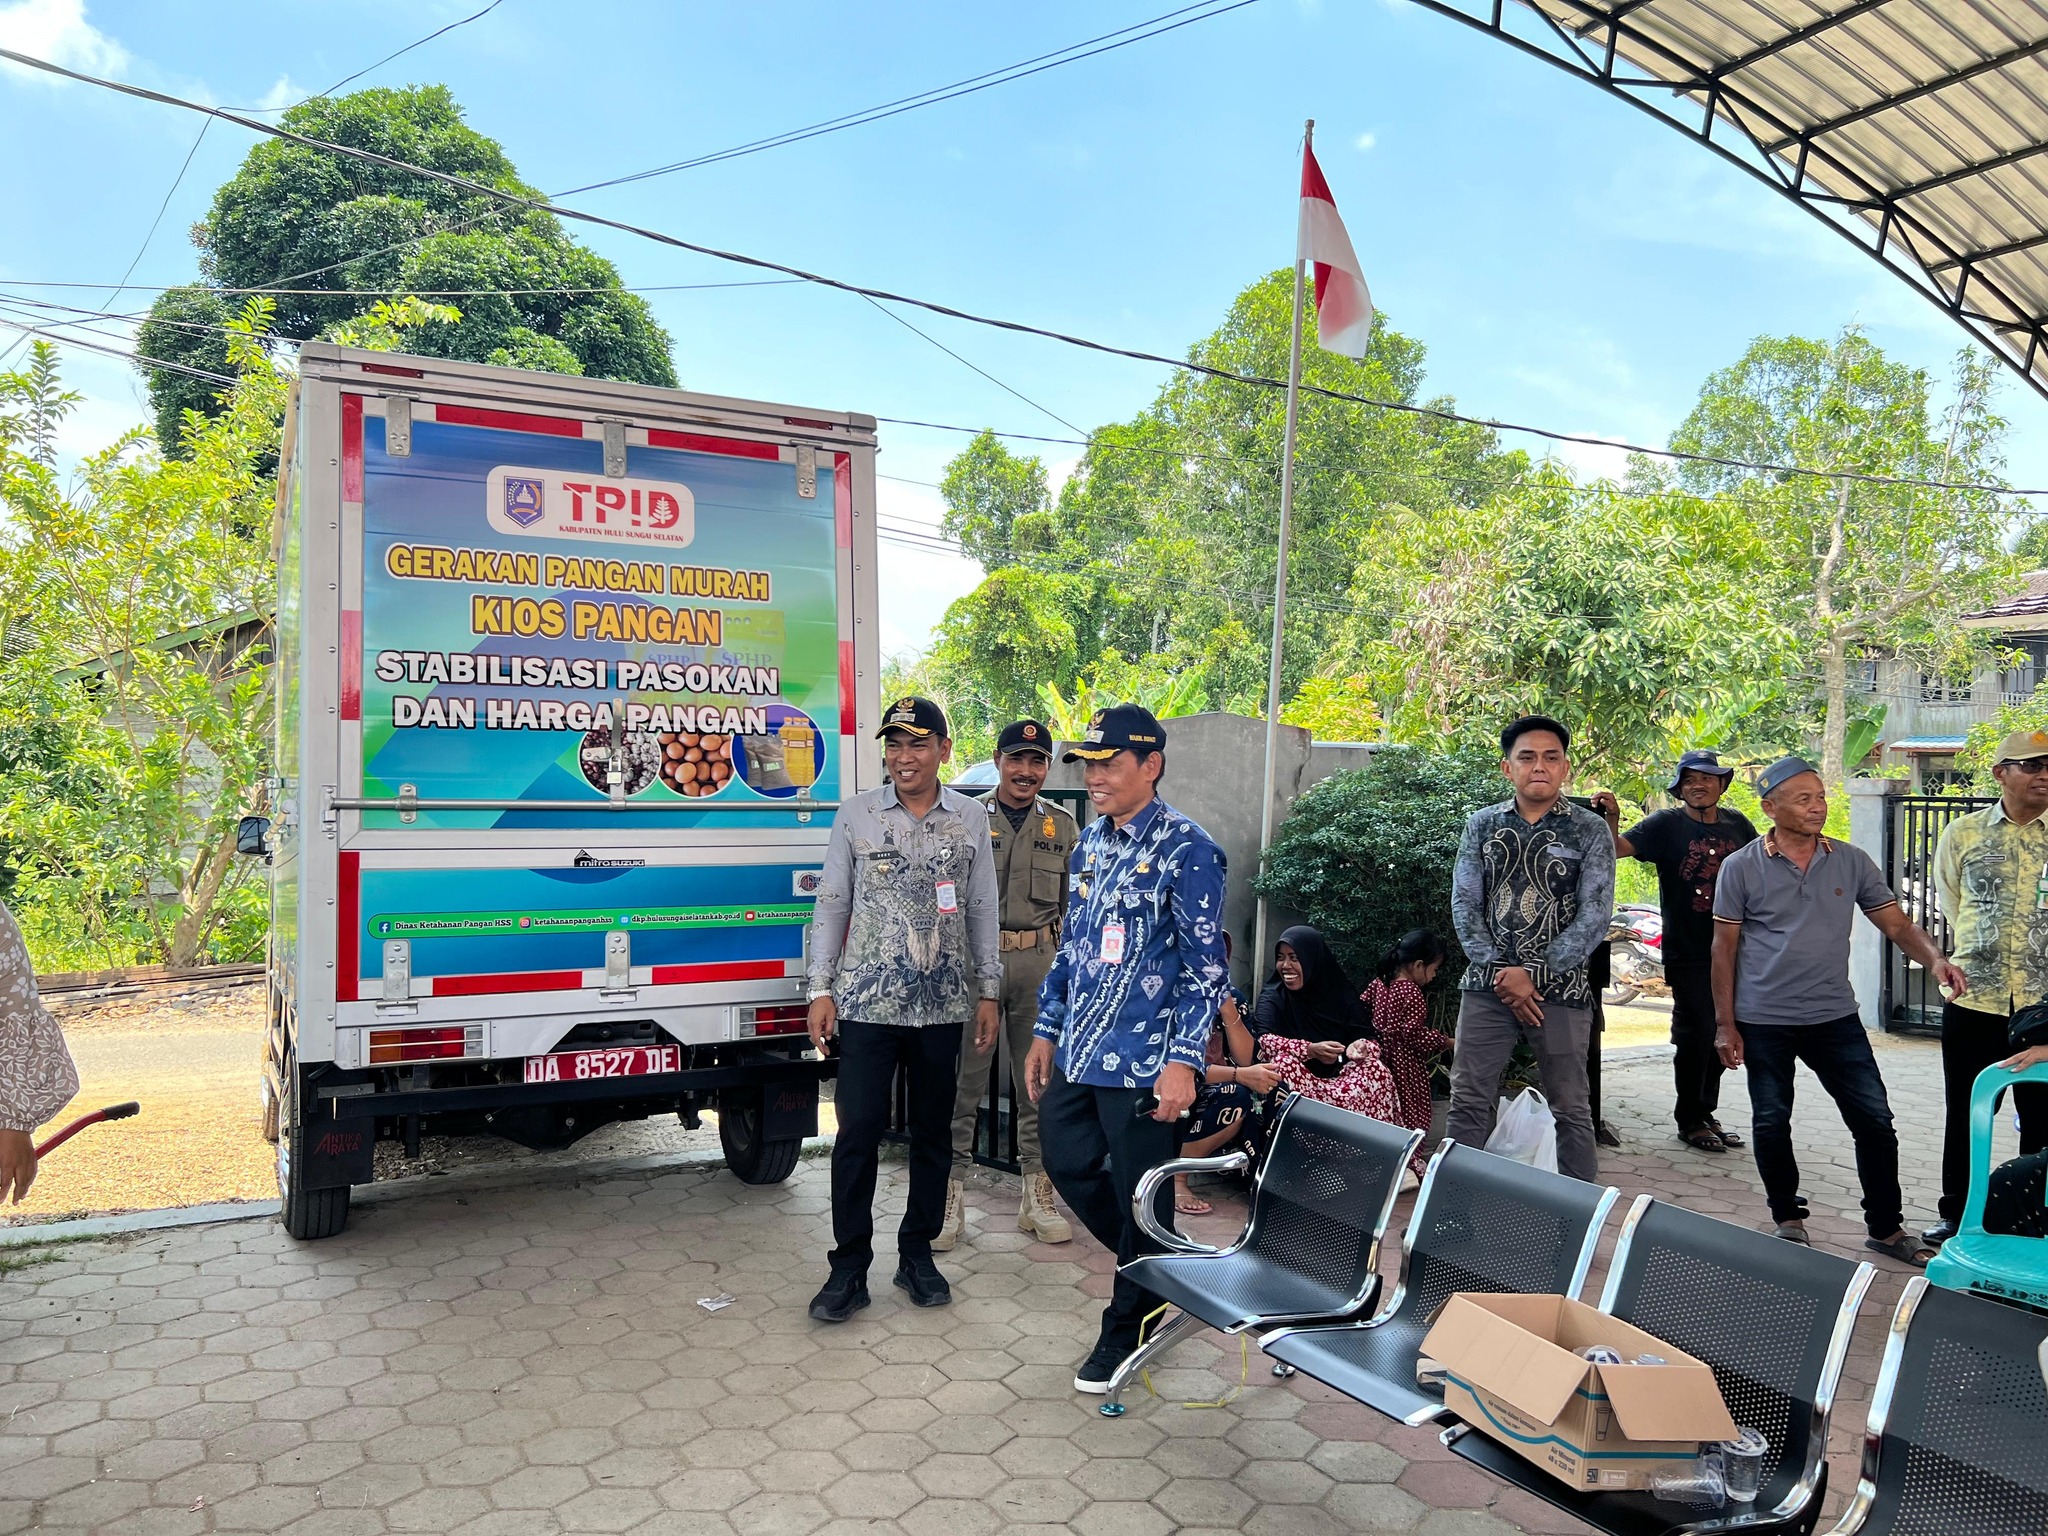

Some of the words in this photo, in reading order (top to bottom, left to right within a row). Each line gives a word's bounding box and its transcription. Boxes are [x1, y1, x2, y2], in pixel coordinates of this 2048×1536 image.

[559, 525, 602, 535] KABUPATEN
[604, 529, 624, 537] HULU
[626, 531, 652, 540] SUNGAI
[654, 533, 684, 542] SELATAN
[387, 544, 539, 587] GERAKAN
[544, 556, 664, 595] PANGAN
[669, 565, 770, 602] MURAH
[471, 594, 567, 638] KIOS
[573, 601, 722, 647] PANGAN
[721, 651, 773, 666] SPHP
[375, 650, 608, 689] STABILISASI
[616, 659, 779, 695] PASOKAN
[392, 695, 477, 729] DAN
[484, 698, 614, 732] HARGA
[625, 702, 768, 735] PANGAN
[1034, 840, 1051, 851] POL
[1053, 843, 1064, 853] PP
[395, 921, 418, 930] Dinas
[419, 920, 463, 930] Ketahanan
[464, 919, 494, 930] Pangan
[494, 918, 512, 927] HSS
[534, 916, 613, 926] ketahananpanganhss
[528, 1057, 561, 1083] DA
[575, 1051, 635, 1080] 8527
[645, 1047, 676, 1074] DE
[331, 1142, 360, 1156] RAYA
[1558, 1449, 1575, 1466] Mineral
